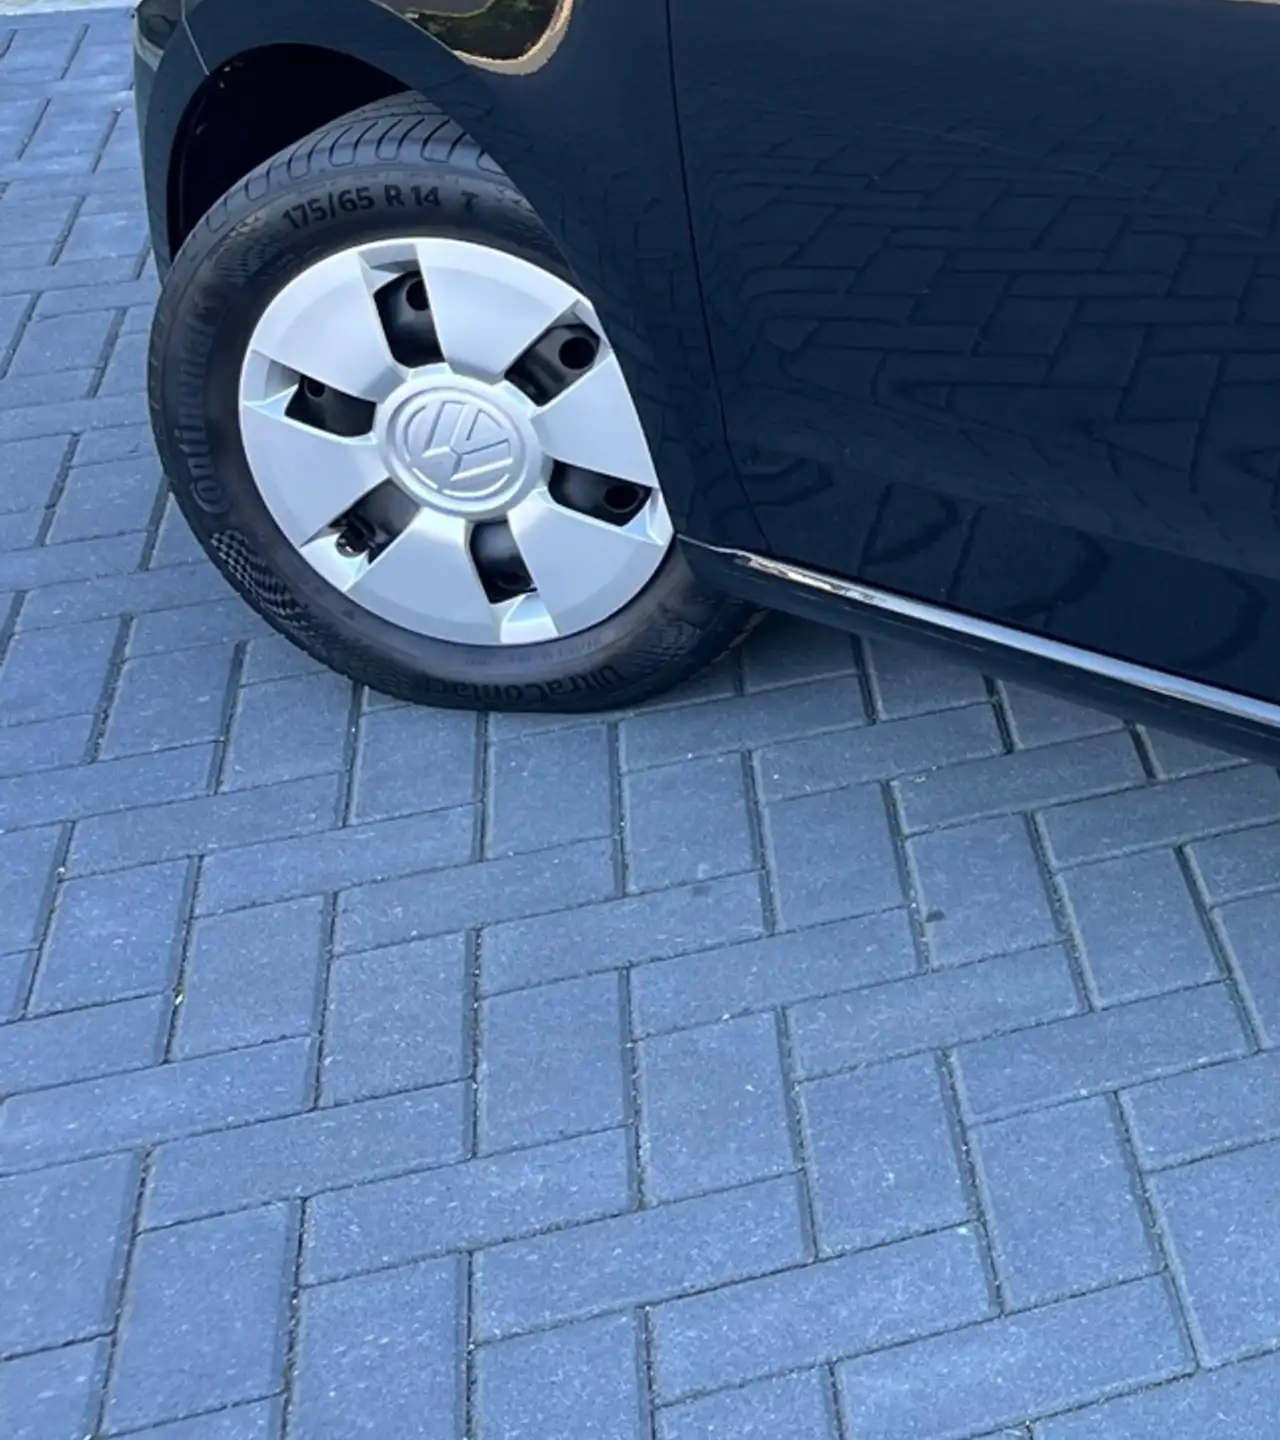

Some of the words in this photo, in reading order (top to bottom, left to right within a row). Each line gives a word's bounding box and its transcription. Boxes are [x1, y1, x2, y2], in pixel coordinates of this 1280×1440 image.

[283, 185, 376, 231] 175/65
[384, 184, 406, 208] R
[410, 185, 442, 209] 14
